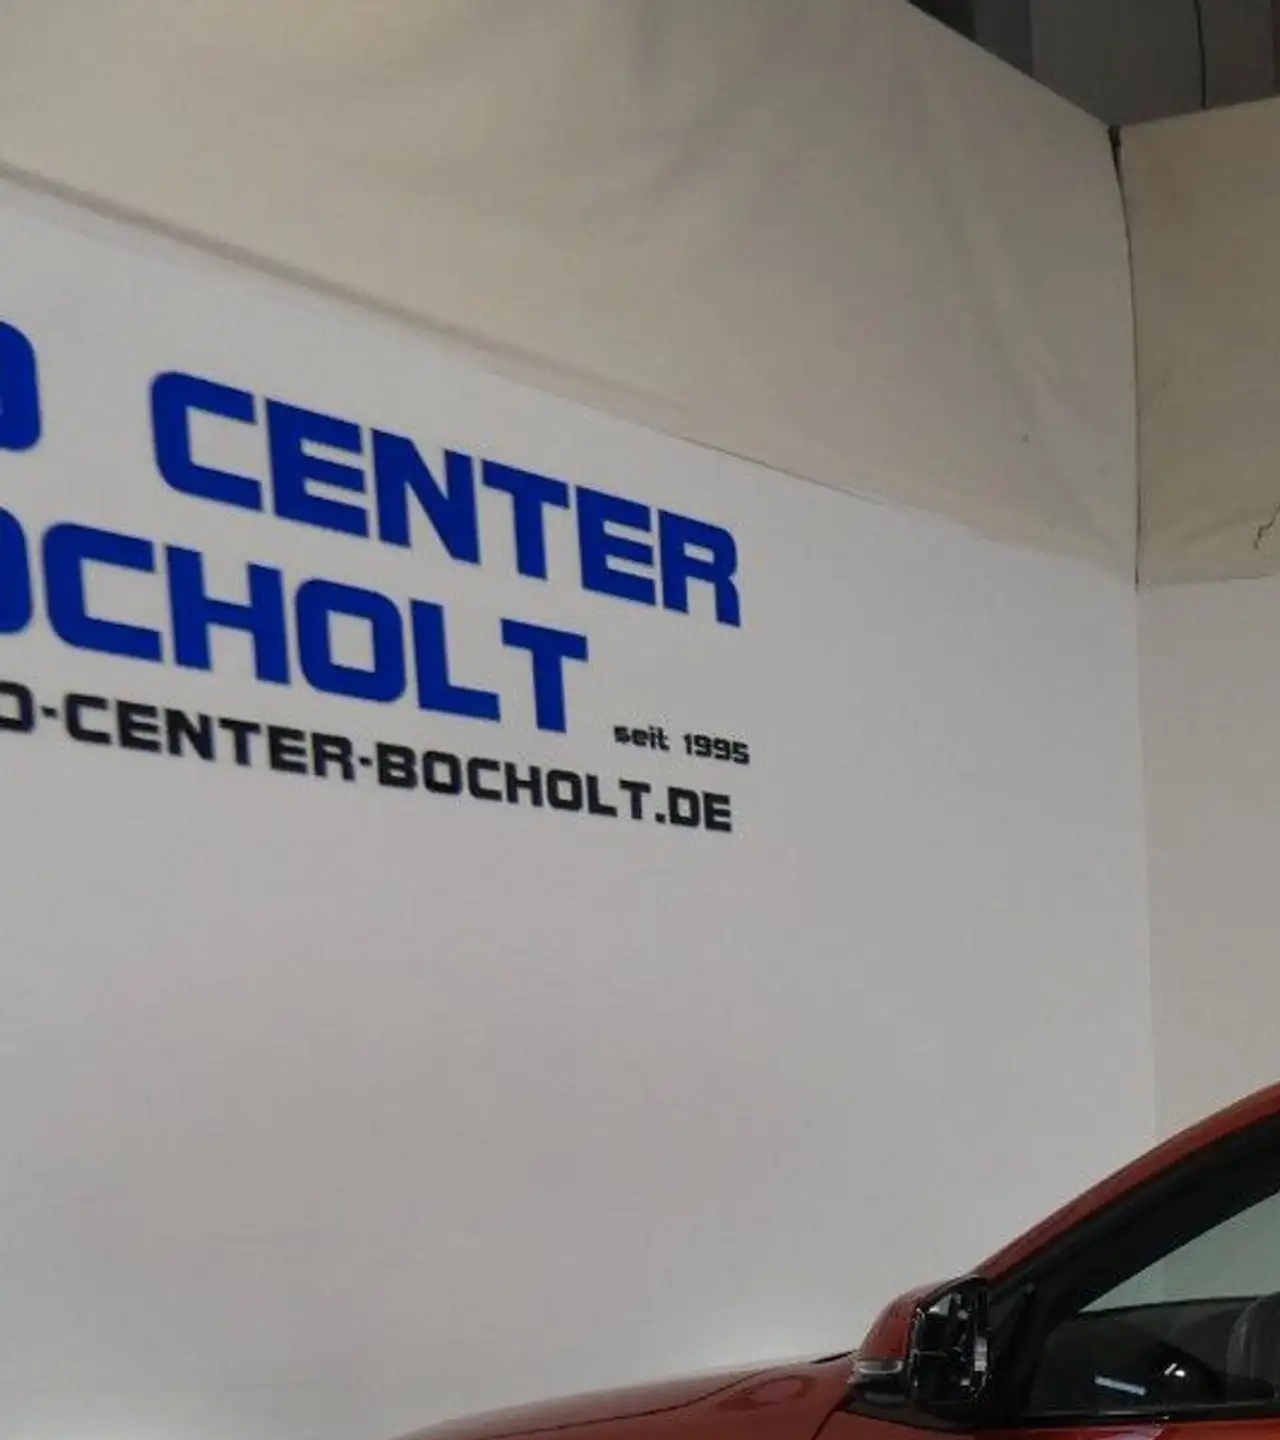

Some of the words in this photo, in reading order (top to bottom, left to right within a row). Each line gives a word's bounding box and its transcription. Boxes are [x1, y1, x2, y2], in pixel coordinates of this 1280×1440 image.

[150, 371, 741, 628] CENTER
[613, 723, 671, 753] seit
[682, 732, 750, 767] 1995
